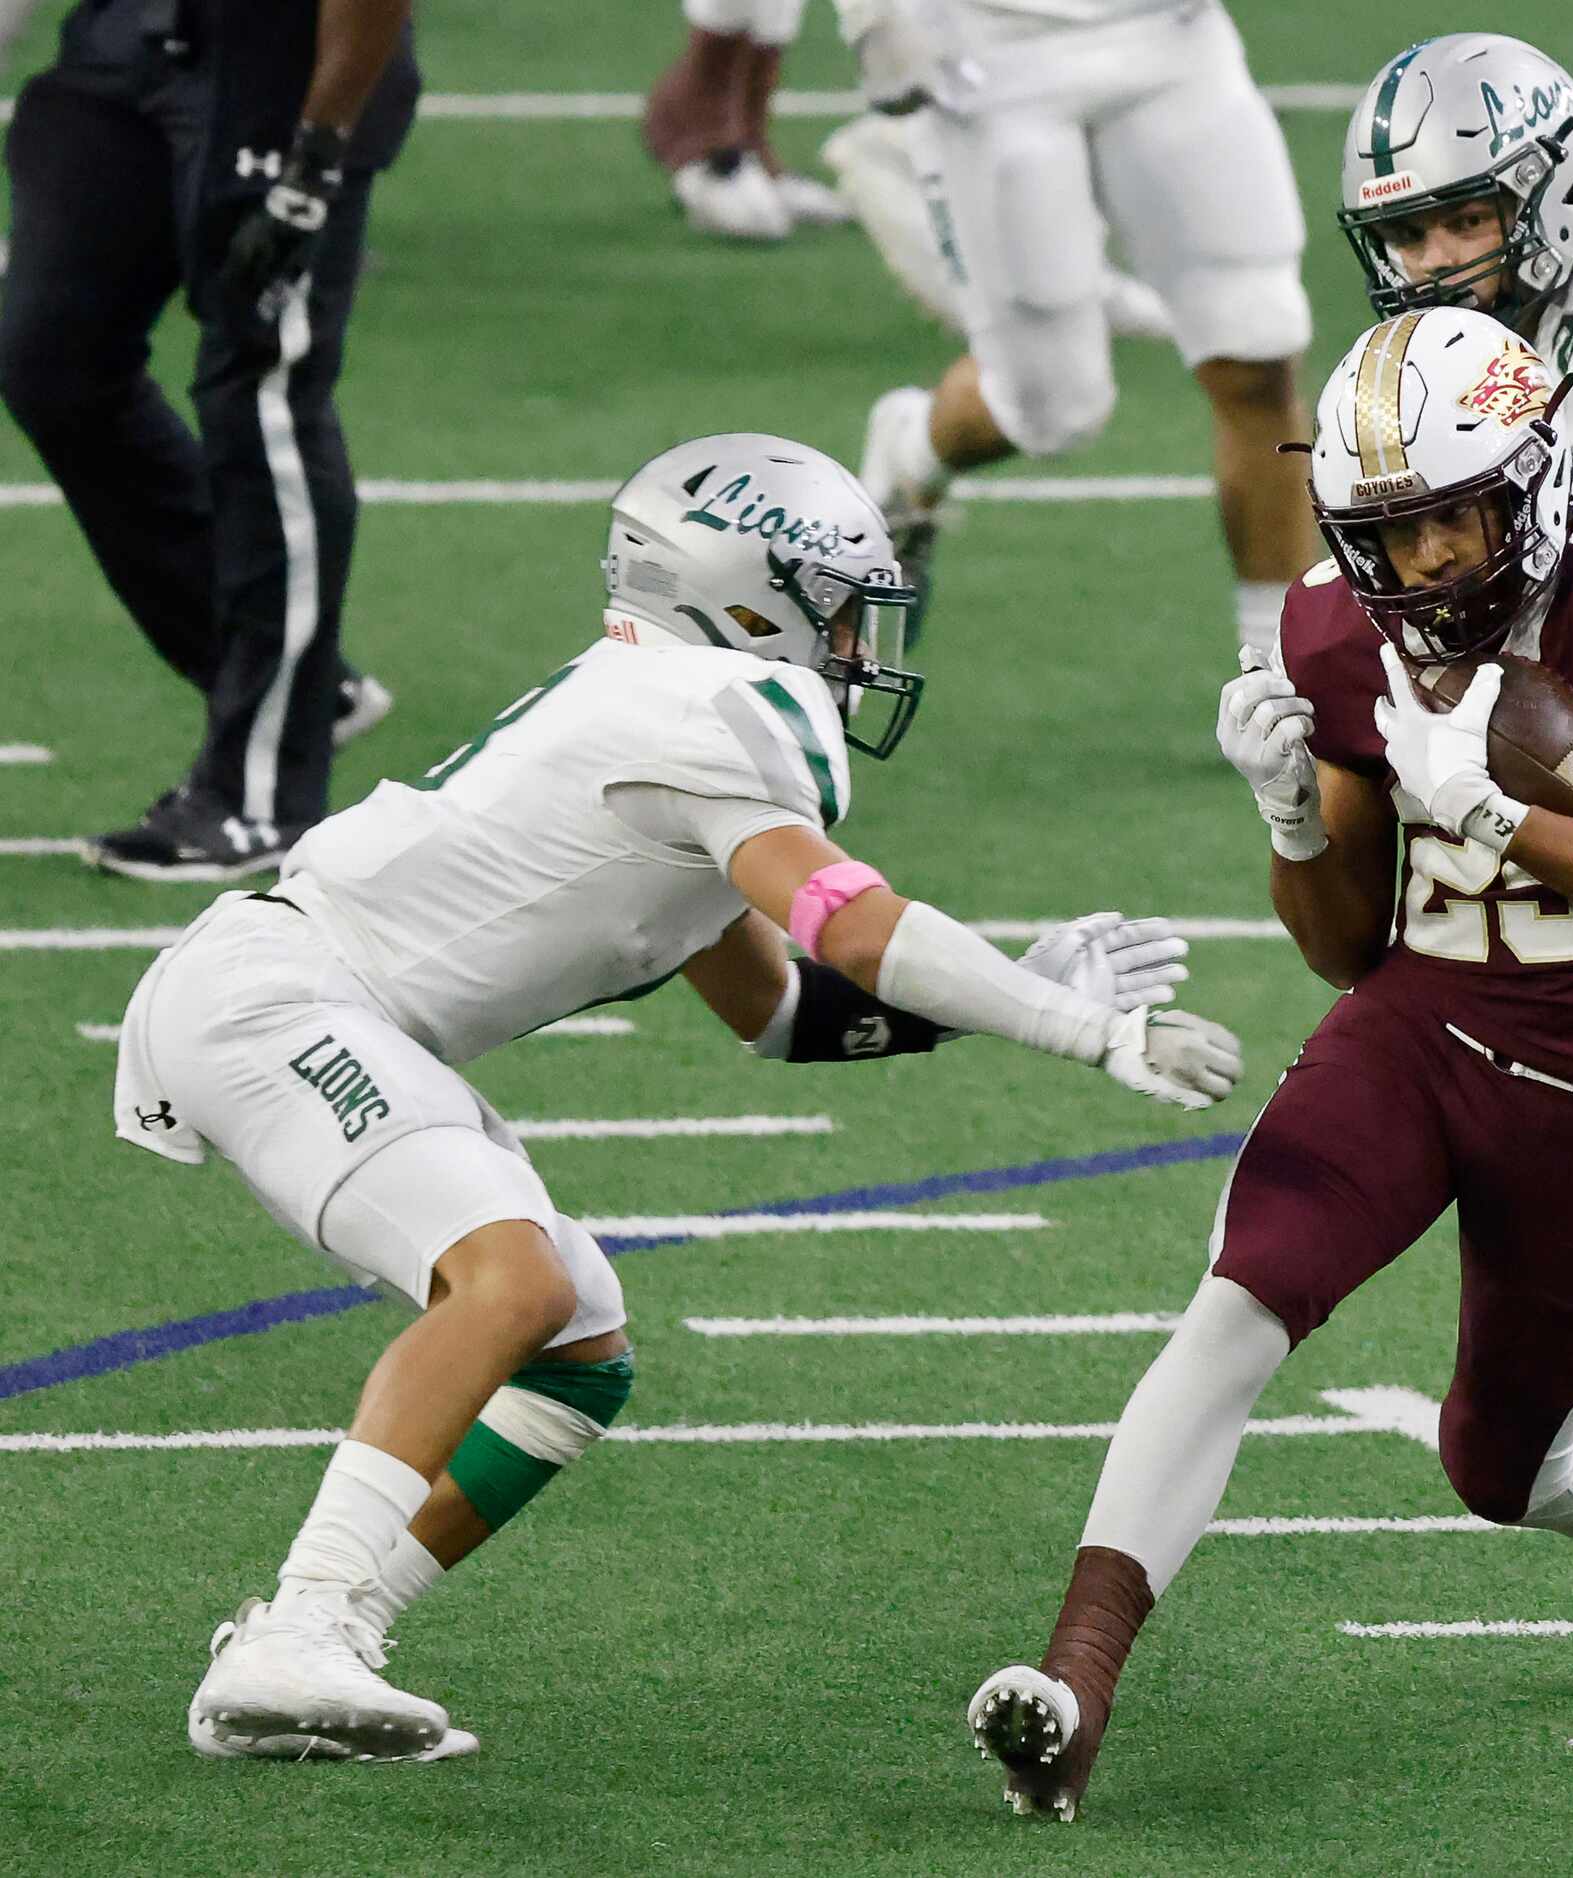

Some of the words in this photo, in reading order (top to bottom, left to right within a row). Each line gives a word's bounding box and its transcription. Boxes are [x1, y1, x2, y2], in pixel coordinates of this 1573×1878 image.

[1362, 176, 1412, 200] Riddell
[1356, 477, 1414, 497] COYOTES
[682, 474, 845, 560] Lions
[288, 1034, 391, 1143] LIONS
